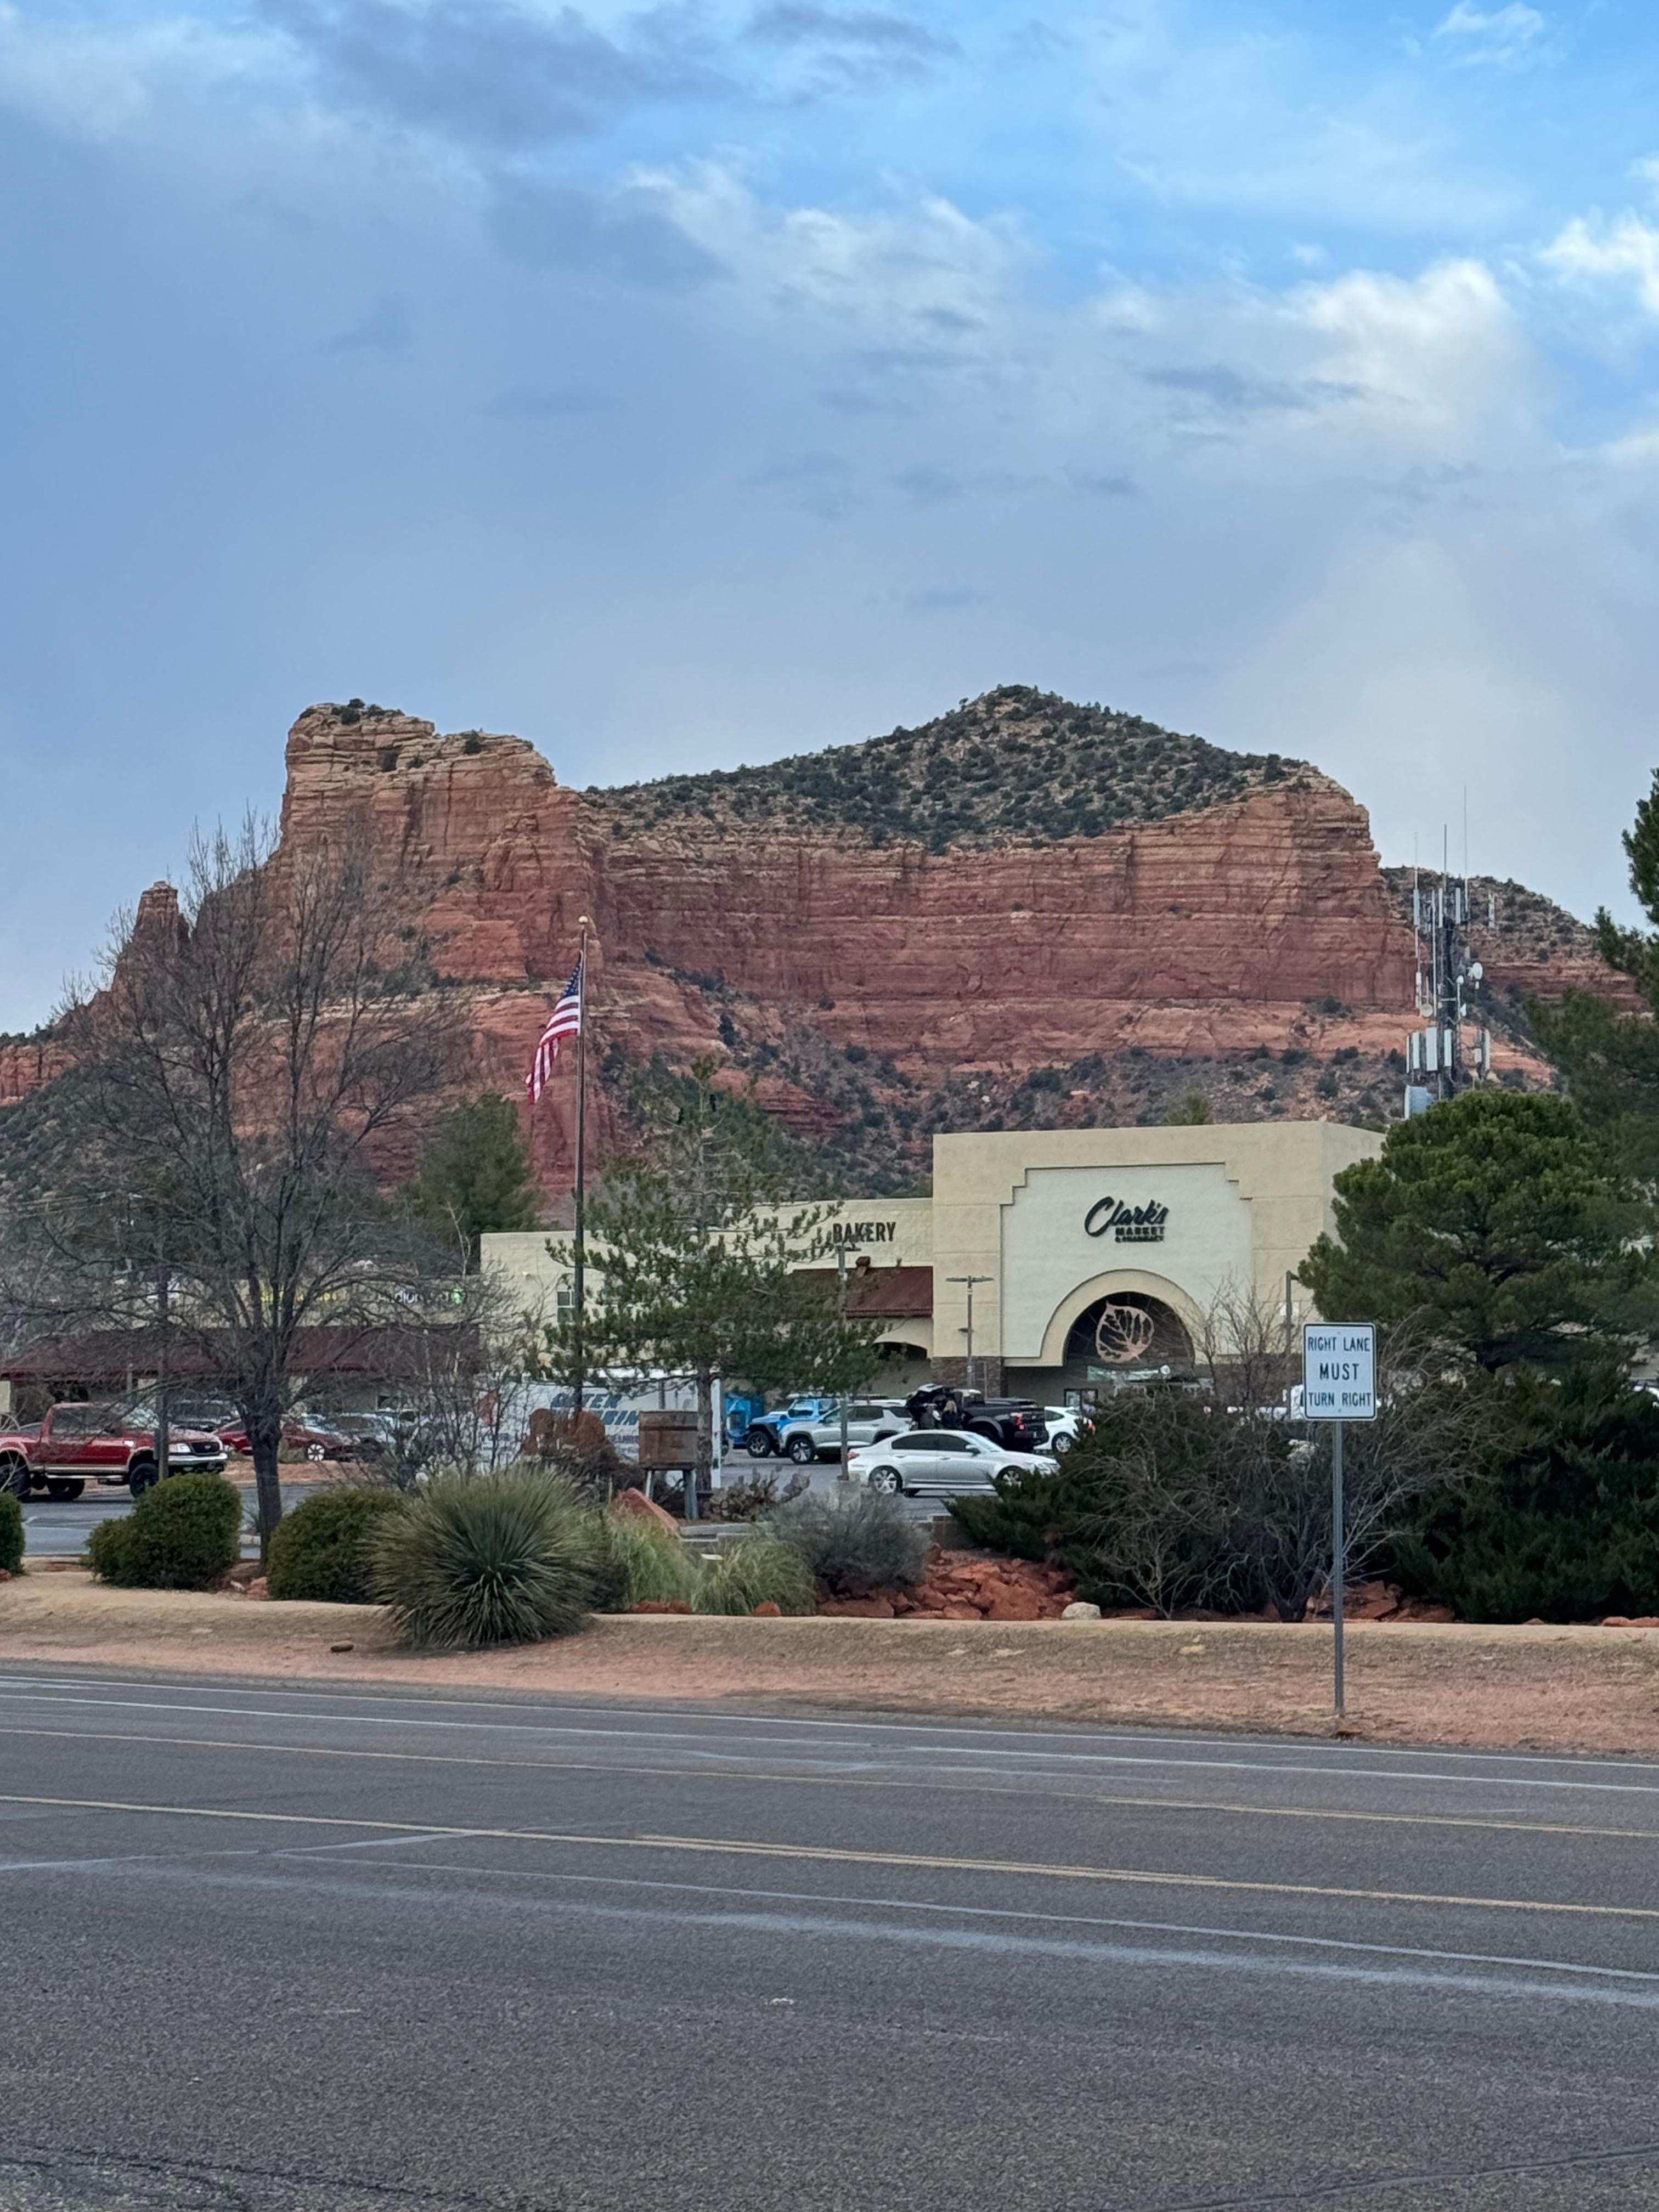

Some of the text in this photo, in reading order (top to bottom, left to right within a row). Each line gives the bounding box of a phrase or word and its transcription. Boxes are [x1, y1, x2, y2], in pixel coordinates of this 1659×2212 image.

[1084, 1195, 1170, 1238] Clark's
[833, 1221, 896, 1243] BAKERY
[1115, 1226, 1165, 1236] MARKET
[1308, 1336, 1370, 1352] RIGHT LANE
[1319, 1363, 1359, 1381] MUST
[1308, 1392, 1372, 1407] TURN RIGHT
